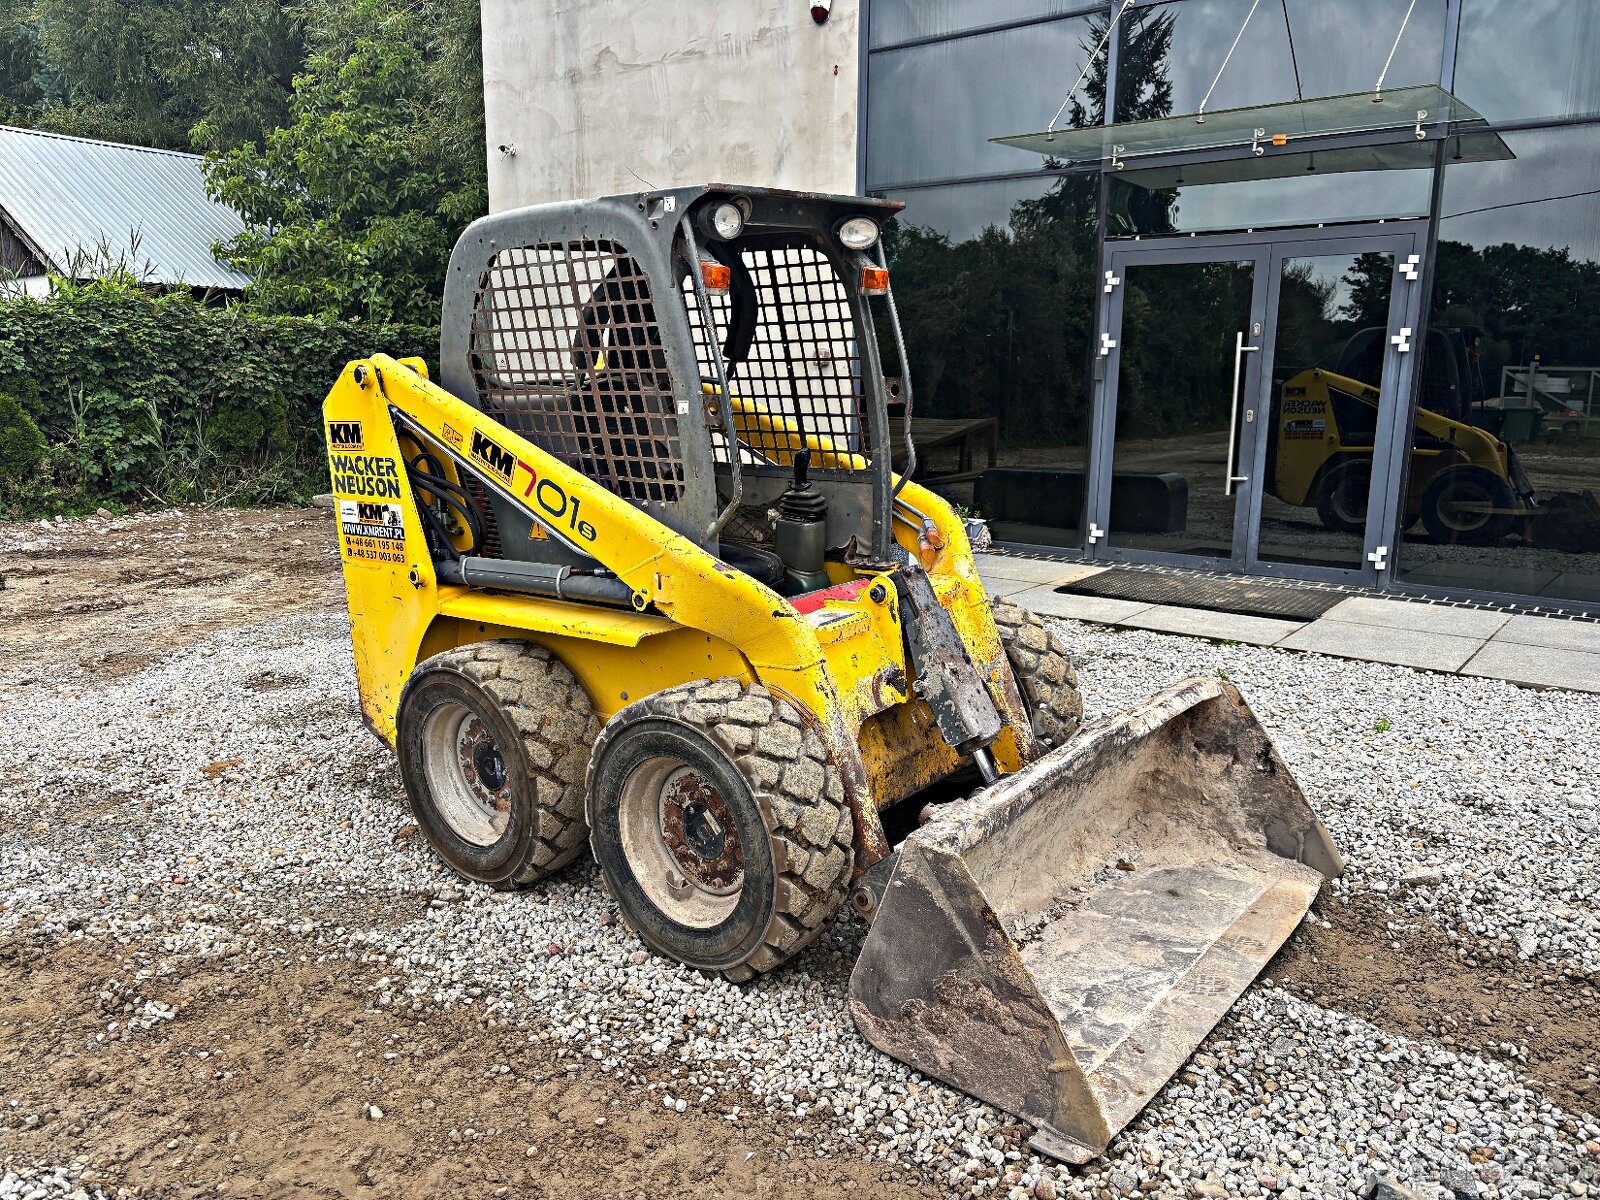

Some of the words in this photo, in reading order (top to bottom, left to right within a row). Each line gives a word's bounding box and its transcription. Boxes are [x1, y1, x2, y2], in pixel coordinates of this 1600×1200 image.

[329, 423, 362, 443] KM
[471, 431, 515, 476] KM
[330, 454, 398, 478] WACKER
[334, 474, 401, 499] NEUSON
[358, 503, 383, 520] KM
[342, 522, 404, 540] WWW.KMRENT.PL
[364, 541, 376, 549] 661
[378, 541, 390, 550] 195
[391, 542, 404, 551] 148
[366, 550, 377, 560] 537
[379, 552, 392, 562] 003
[392, 553, 405, 563] 063
